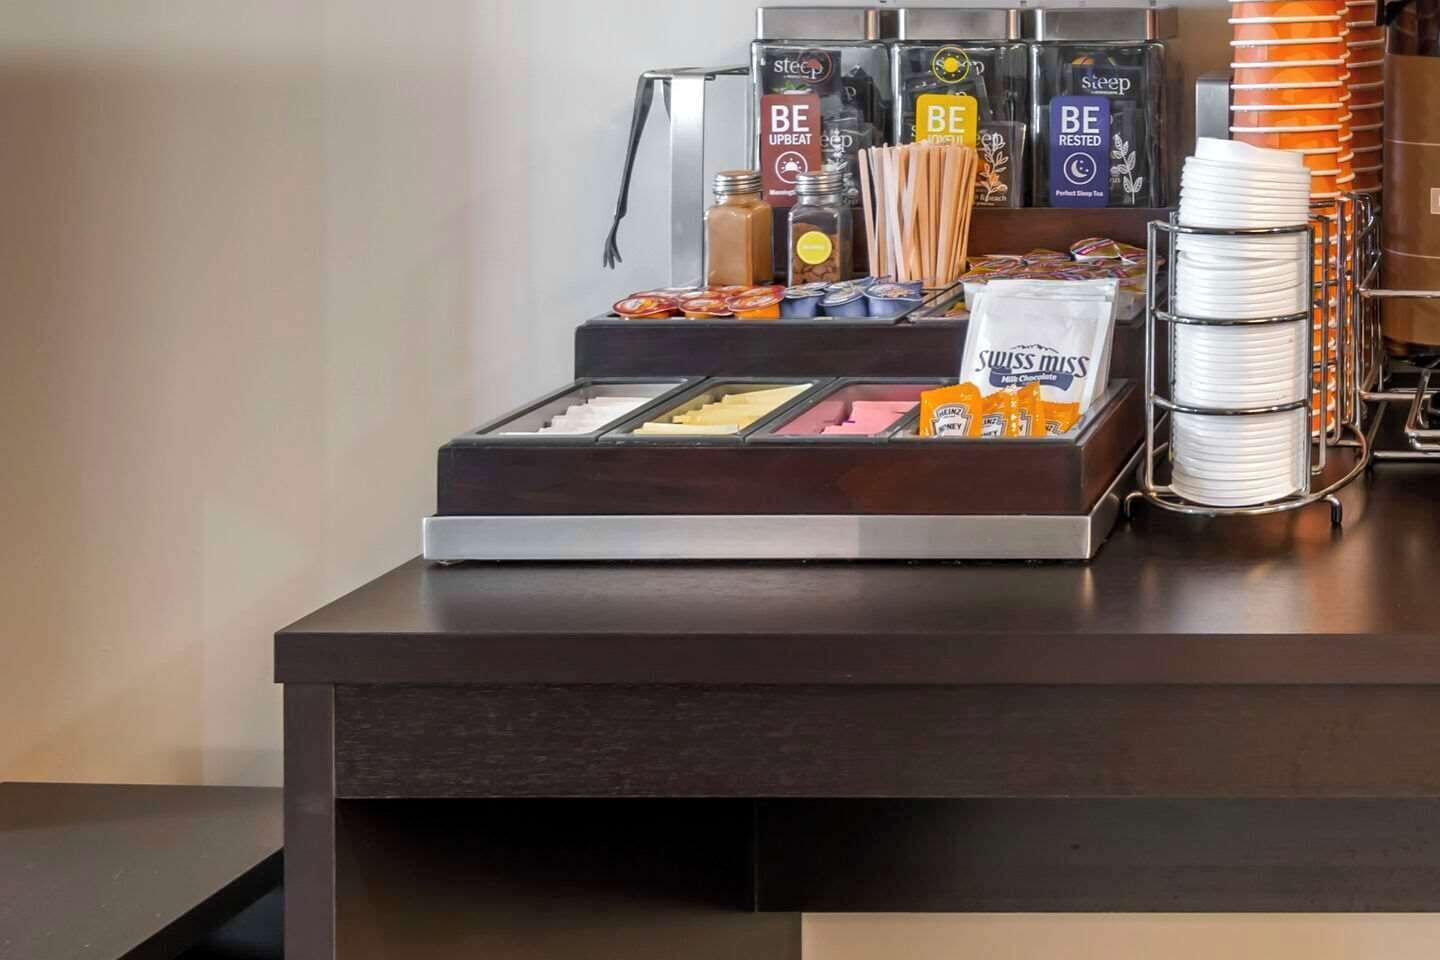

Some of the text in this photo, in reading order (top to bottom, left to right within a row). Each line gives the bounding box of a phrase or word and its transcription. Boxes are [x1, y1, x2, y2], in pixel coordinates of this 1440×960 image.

[1081, 74, 1131, 95] steep
[771, 105, 809, 133] BE
[928, 106, 966, 133] BE
[1061, 106, 1100, 133] BE
[769, 134, 812, 145] UPBEAT
[1059, 135, 1102, 146] RESTED
